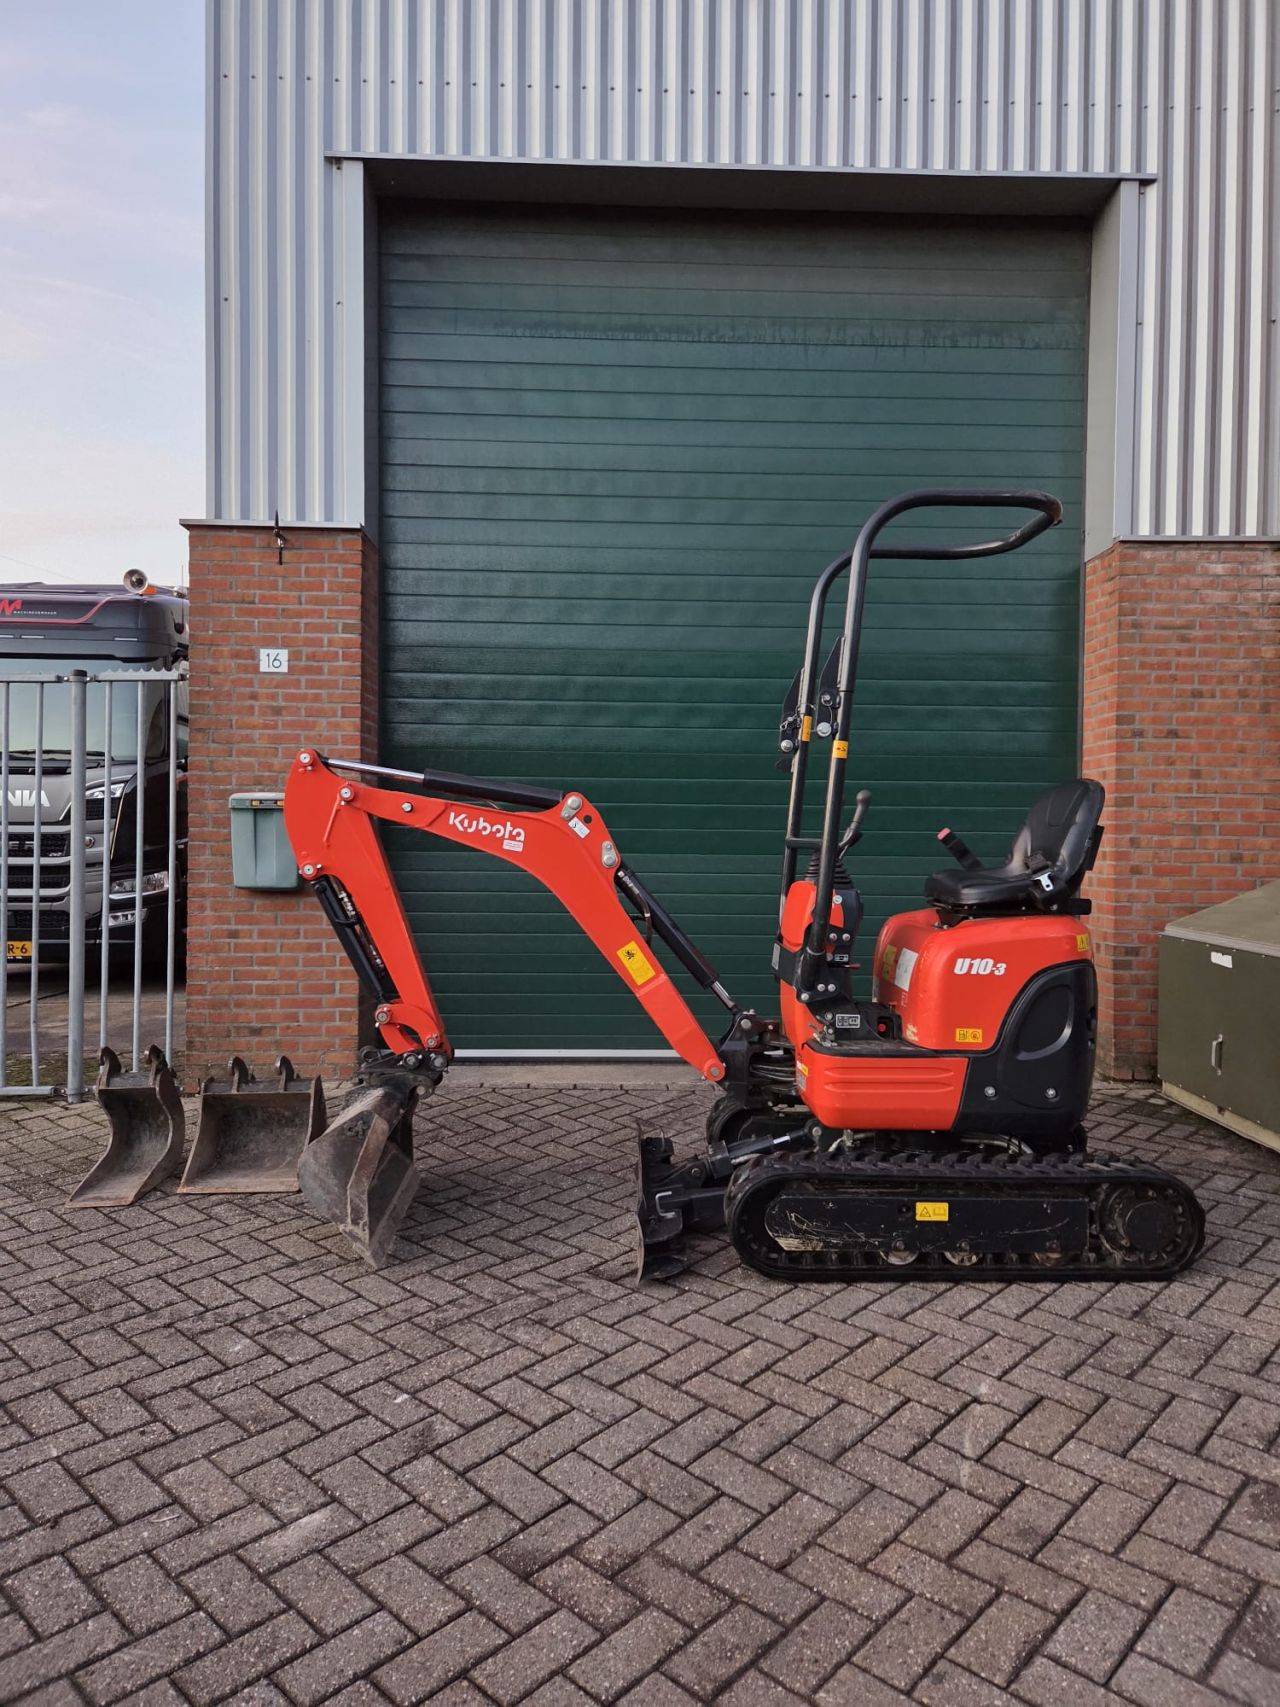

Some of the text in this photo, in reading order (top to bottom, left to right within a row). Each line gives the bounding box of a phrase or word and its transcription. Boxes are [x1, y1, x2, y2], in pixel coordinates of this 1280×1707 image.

[266, 652, 282, 669] 16
[448, 811, 526, 842] Kubota
[953, 957, 1007, 976] U10-3
